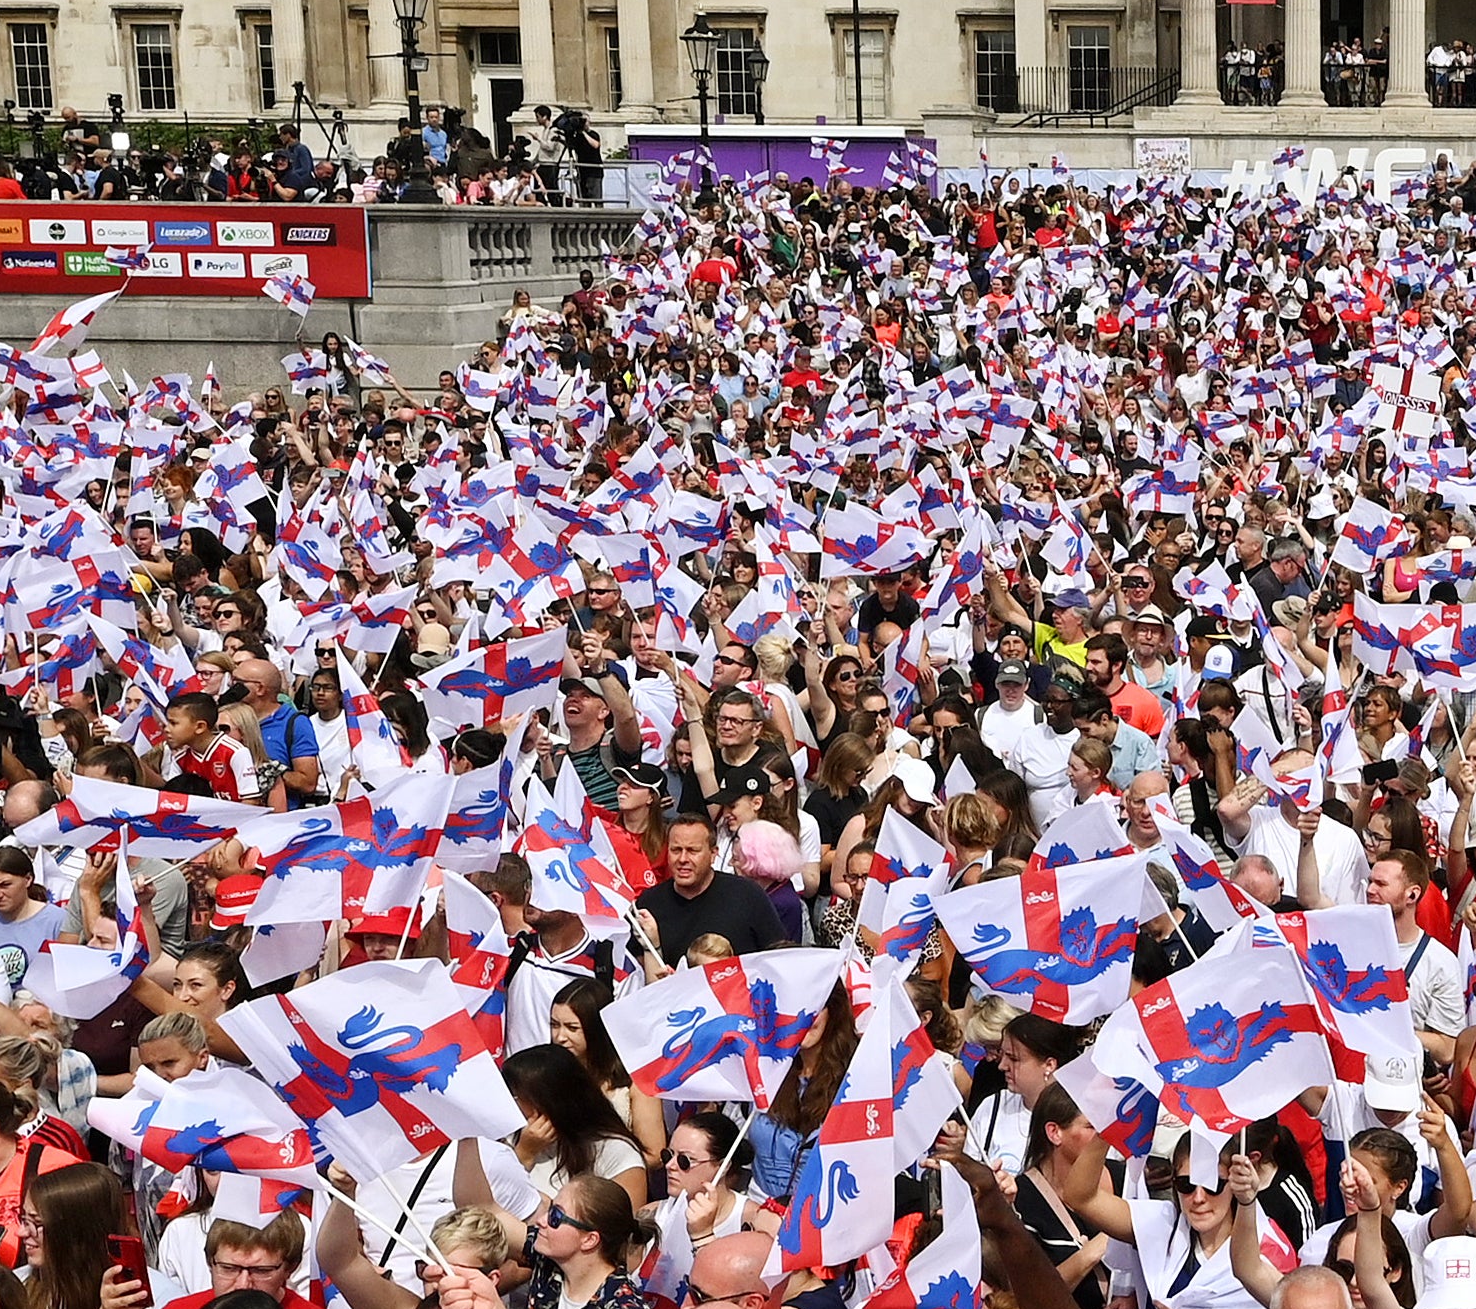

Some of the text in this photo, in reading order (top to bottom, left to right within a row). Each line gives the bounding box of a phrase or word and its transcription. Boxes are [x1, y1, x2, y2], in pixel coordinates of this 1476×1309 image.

[159, 227, 201, 239] Lucozade
[238, 228, 270, 239] XBOX
[288, 228, 329, 240] SNICKERS
[14, 257, 57, 268] Nationwide
[84, 263, 111, 274] Health
[152, 258, 169, 270] LG
[206, 261, 239, 272] PayPal
